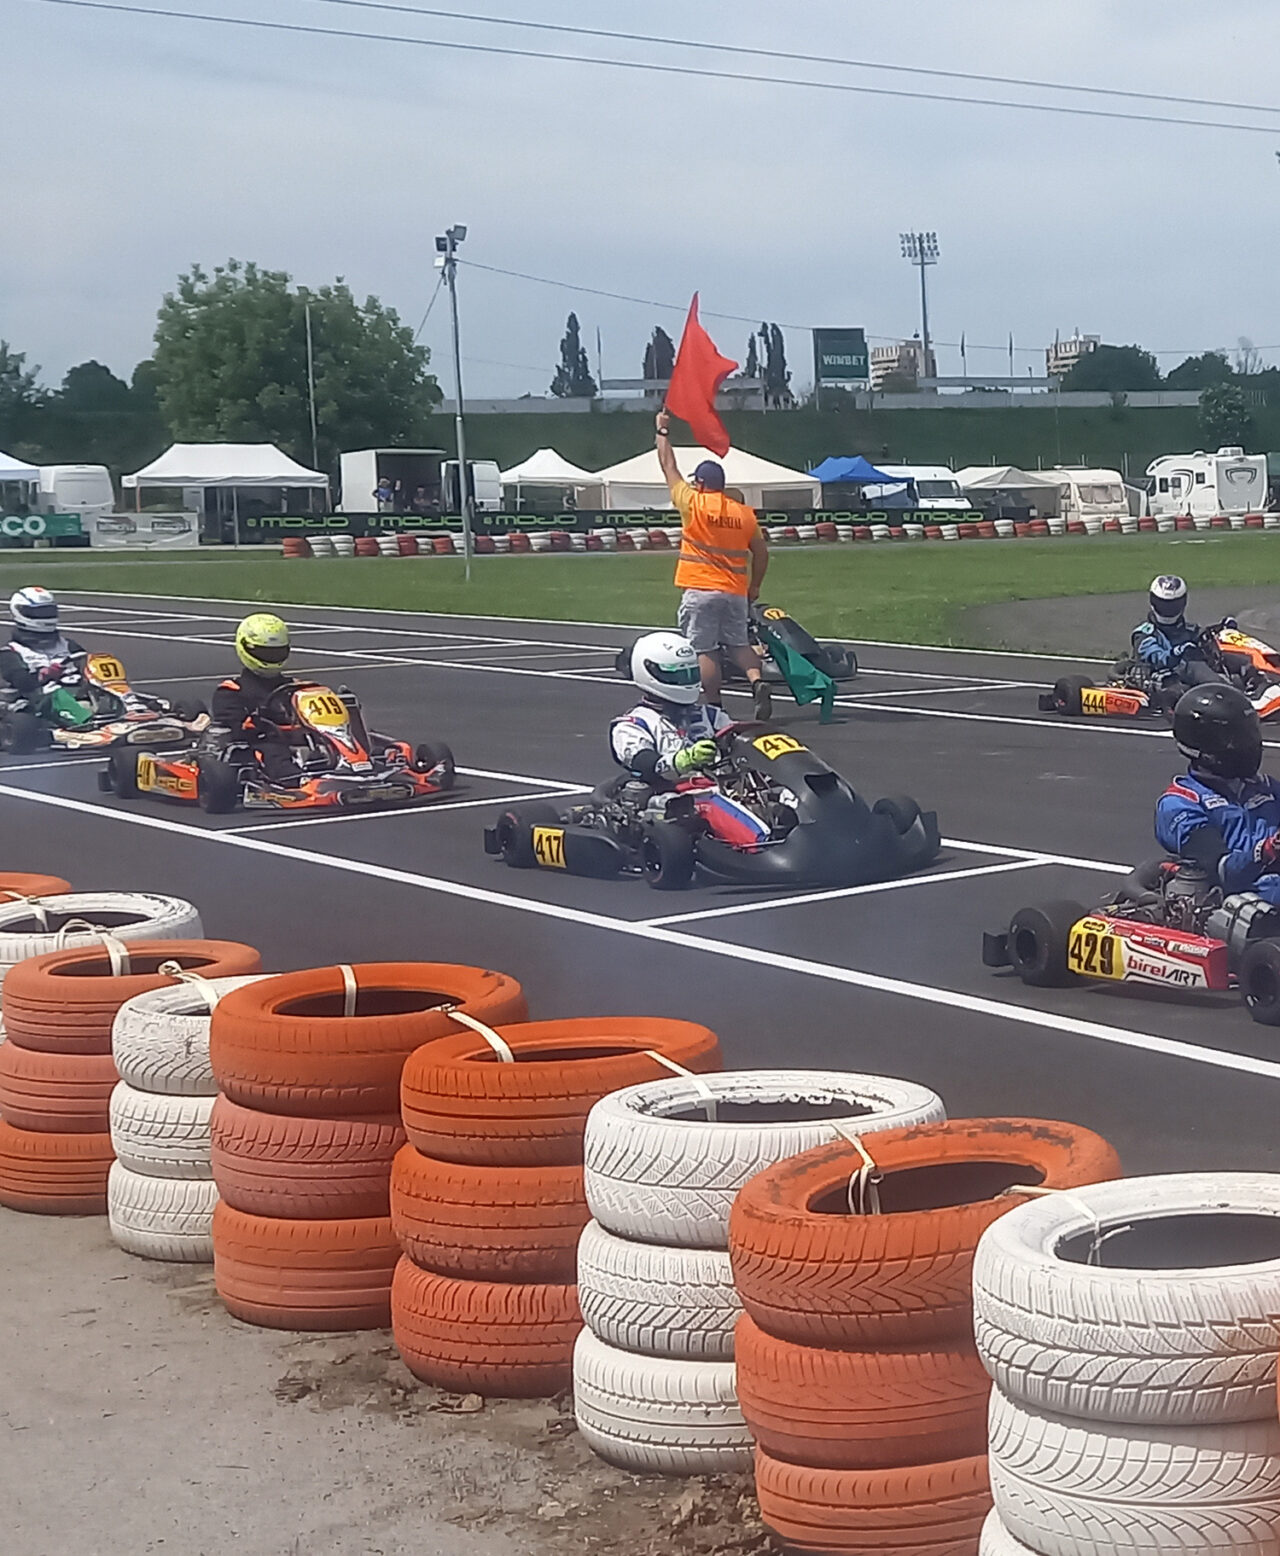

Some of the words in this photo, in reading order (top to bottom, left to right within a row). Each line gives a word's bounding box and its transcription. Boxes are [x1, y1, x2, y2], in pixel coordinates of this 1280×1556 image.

[822, 354, 866, 366] WINBET
[260, 516, 349, 528] MOJO
[380, 516, 464, 527] MOJO
[495, 515, 577, 526] MOJO
[815, 512, 887, 522] MOJO
[913, 512, 984, 522] MOJO
[0, 515, 46, 536] CO
[308, 696, 343, 716] 419
[1083, 693, 1105, 713] 444
[536, 833, 561, 863] 417
[1070, 933, 1115, 975] 429
[1127, 955, 1201, 986] birelART
